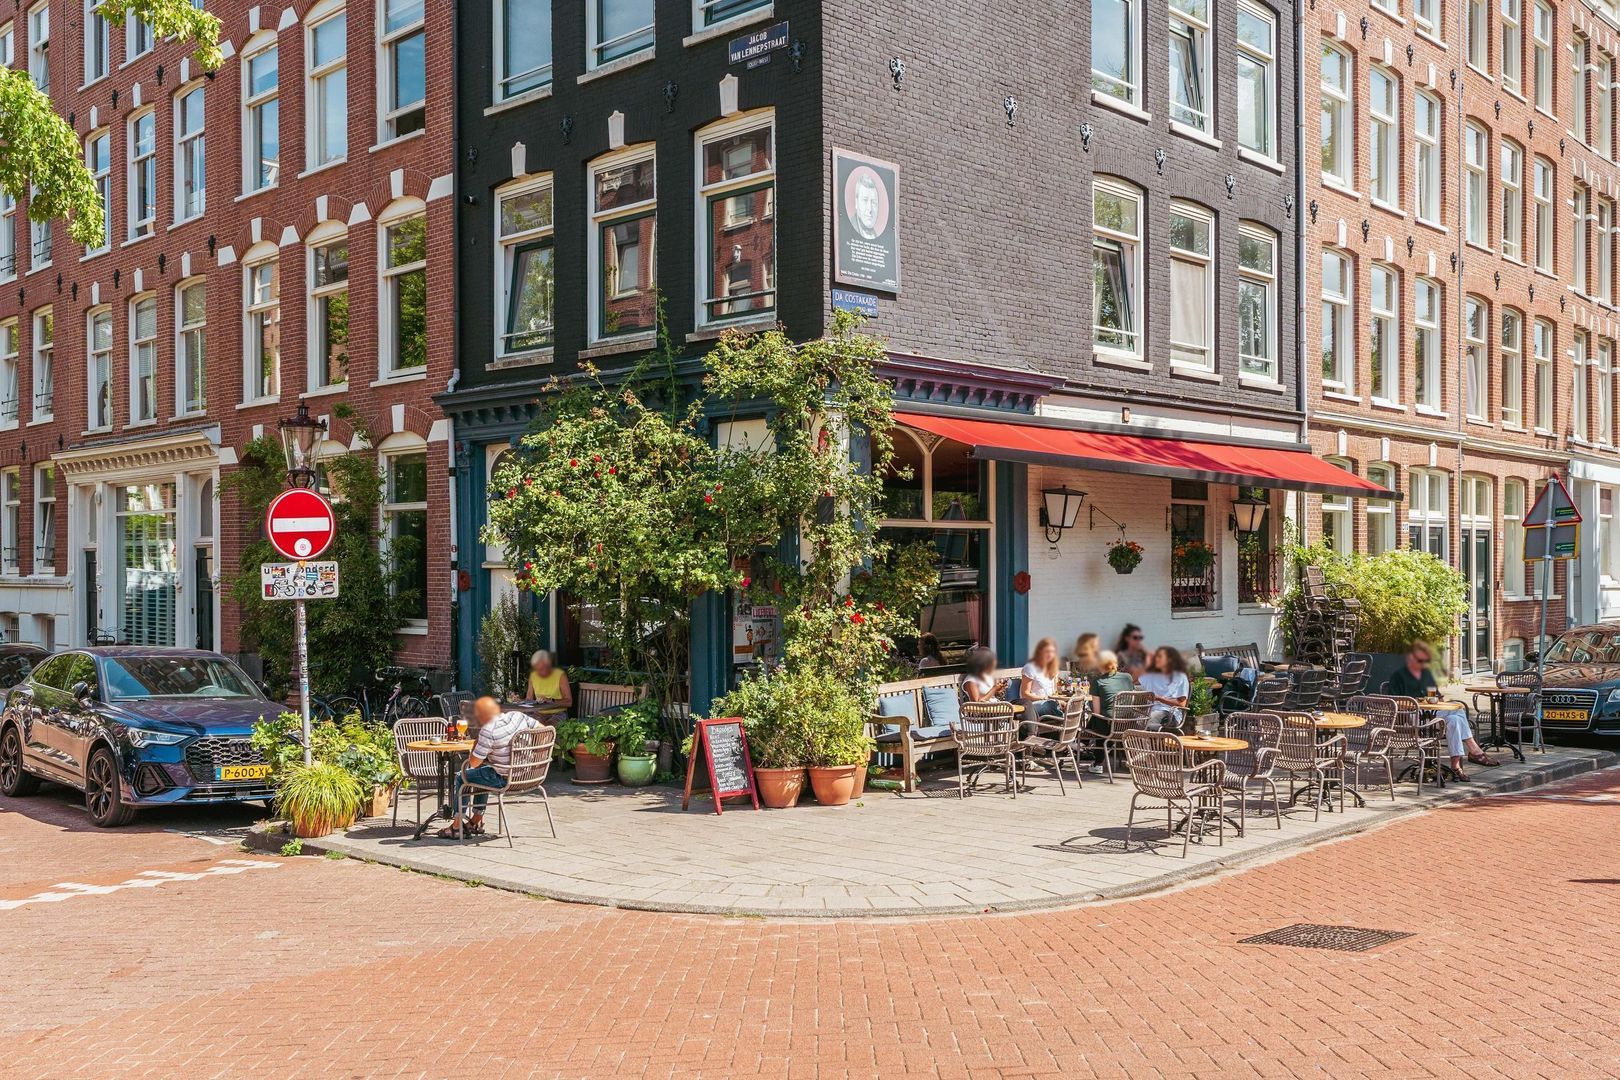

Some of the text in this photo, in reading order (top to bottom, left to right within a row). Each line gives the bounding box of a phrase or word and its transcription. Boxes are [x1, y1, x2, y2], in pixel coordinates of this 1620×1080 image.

[749, 31, 768, 45] JACOB
[731, 35, 786, 62] VAN LENNEPSTRAAT
[834, 293, 877, 307] DA COSTAKADE
[1545, 710, 1585, 720] 20-HXS-8
